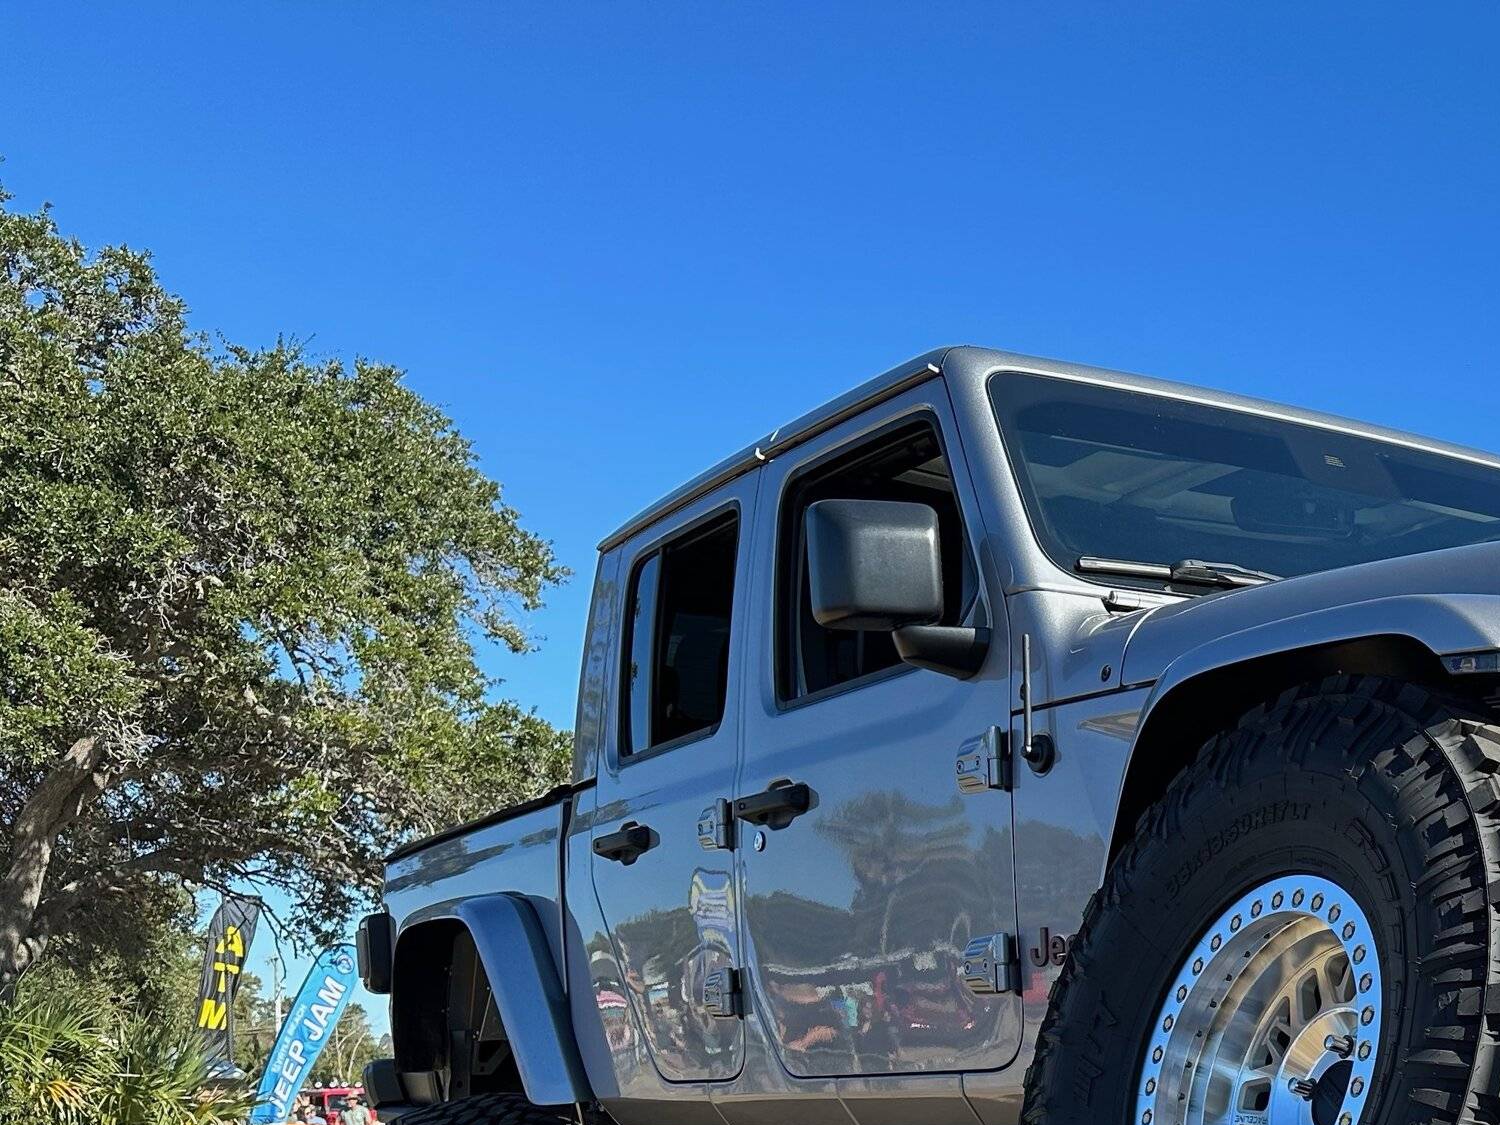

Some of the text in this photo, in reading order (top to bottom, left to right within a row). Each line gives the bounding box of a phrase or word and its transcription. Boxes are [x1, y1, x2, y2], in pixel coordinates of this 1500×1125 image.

[286, 1003, 308, 1037] BEACH
[269, 1039, 307, 1119] JEEP
[304, 975, 346, 1042] JAM
[1234, 1114, 1269, 1125] RACELINE
